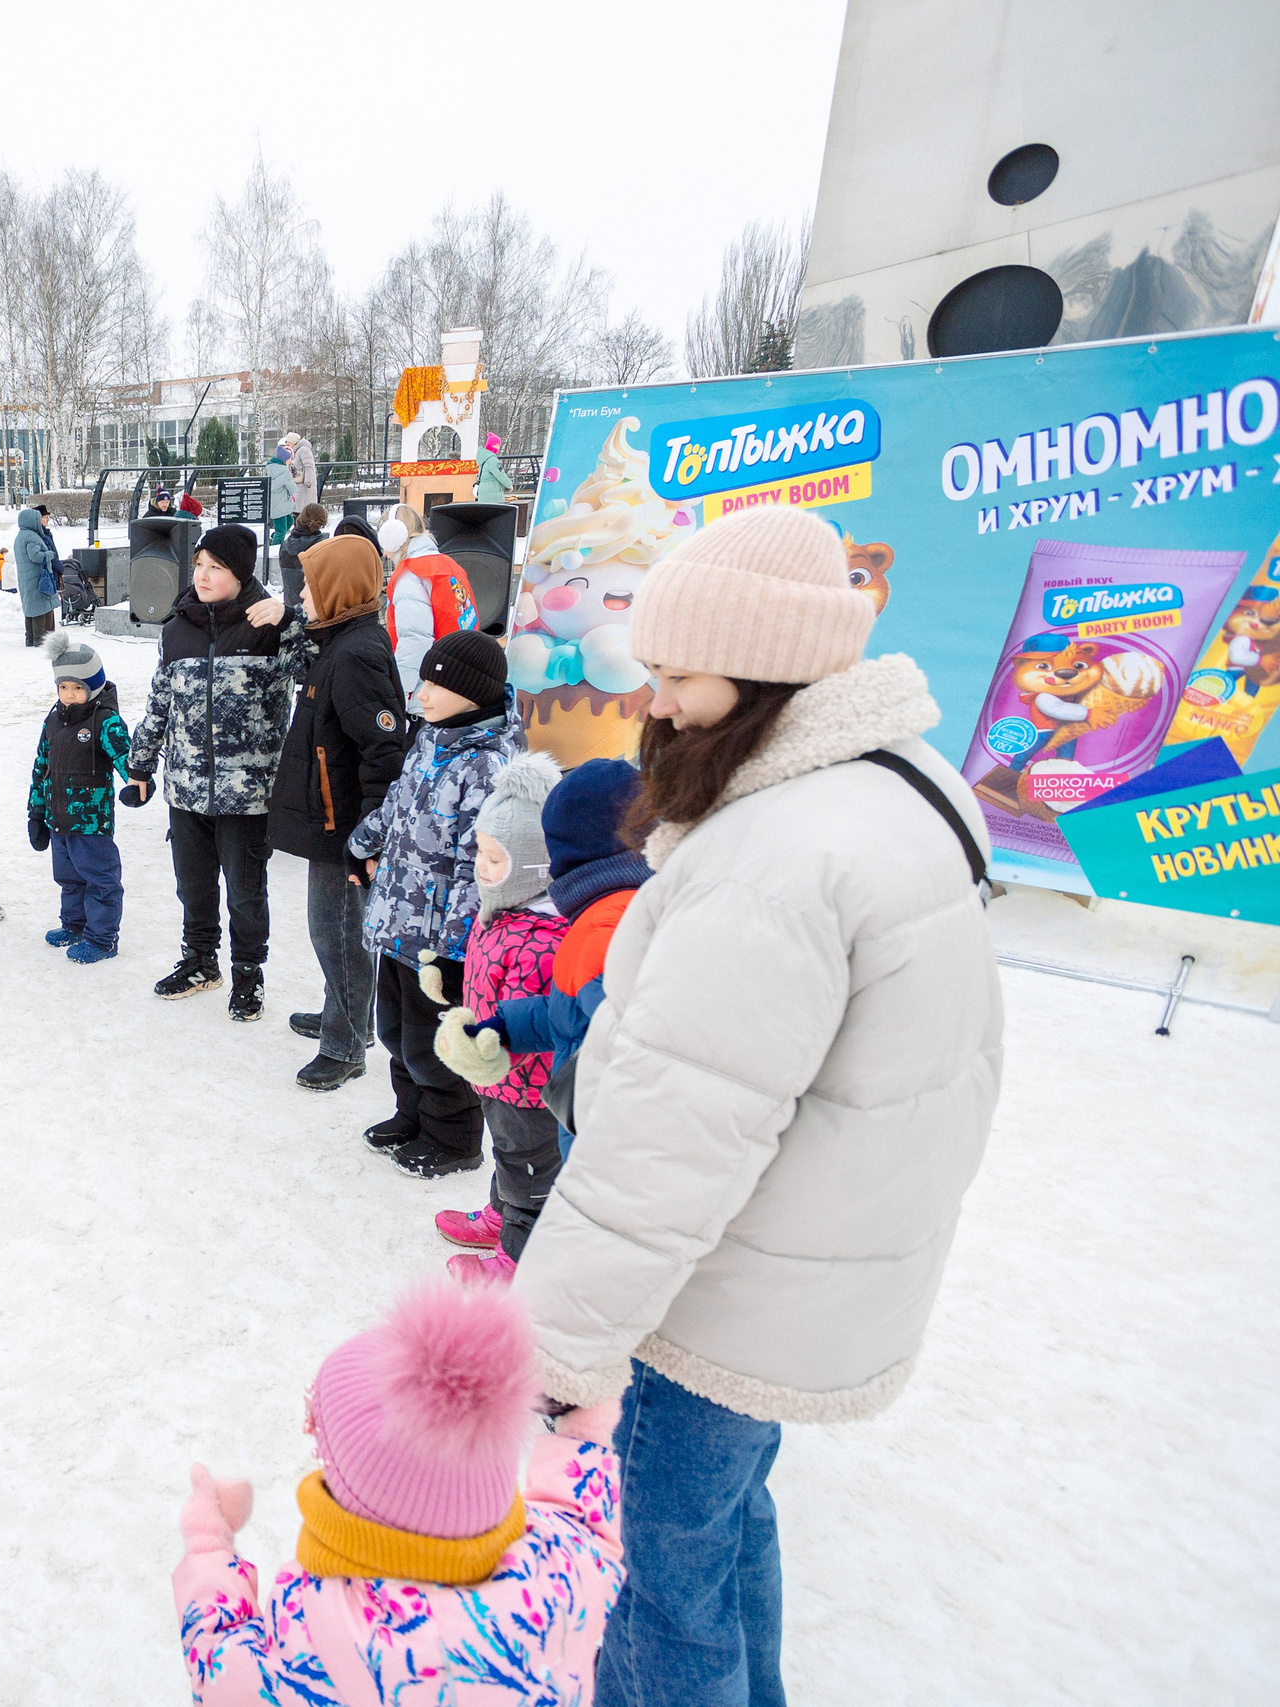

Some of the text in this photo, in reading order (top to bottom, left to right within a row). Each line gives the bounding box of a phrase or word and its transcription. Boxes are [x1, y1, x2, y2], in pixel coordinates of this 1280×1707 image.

[600, 406, 621, 418] Бум
[942, 376, 1280, 501] ОМНОМНО
[978, 506, 999, 534] И
[1008, 488, 1099, 530] ХРУМ
[1131, 462, 1237, 509] ХРУМ
[1043, 576, 1114, 588] НОВЫЙ ВКУС
[1085, 614, 1174, 636] PARTY BOOM
[1189, 712, 1249, 734] МАНГО
[993, 740, 1013, 752] ГОСТ
[1033, 788, 1086, 799] КОКОС
[999, 816, 1030, 826] ПЛОМБИР
[1136, 782, 1280, 843] КРУТЫ
